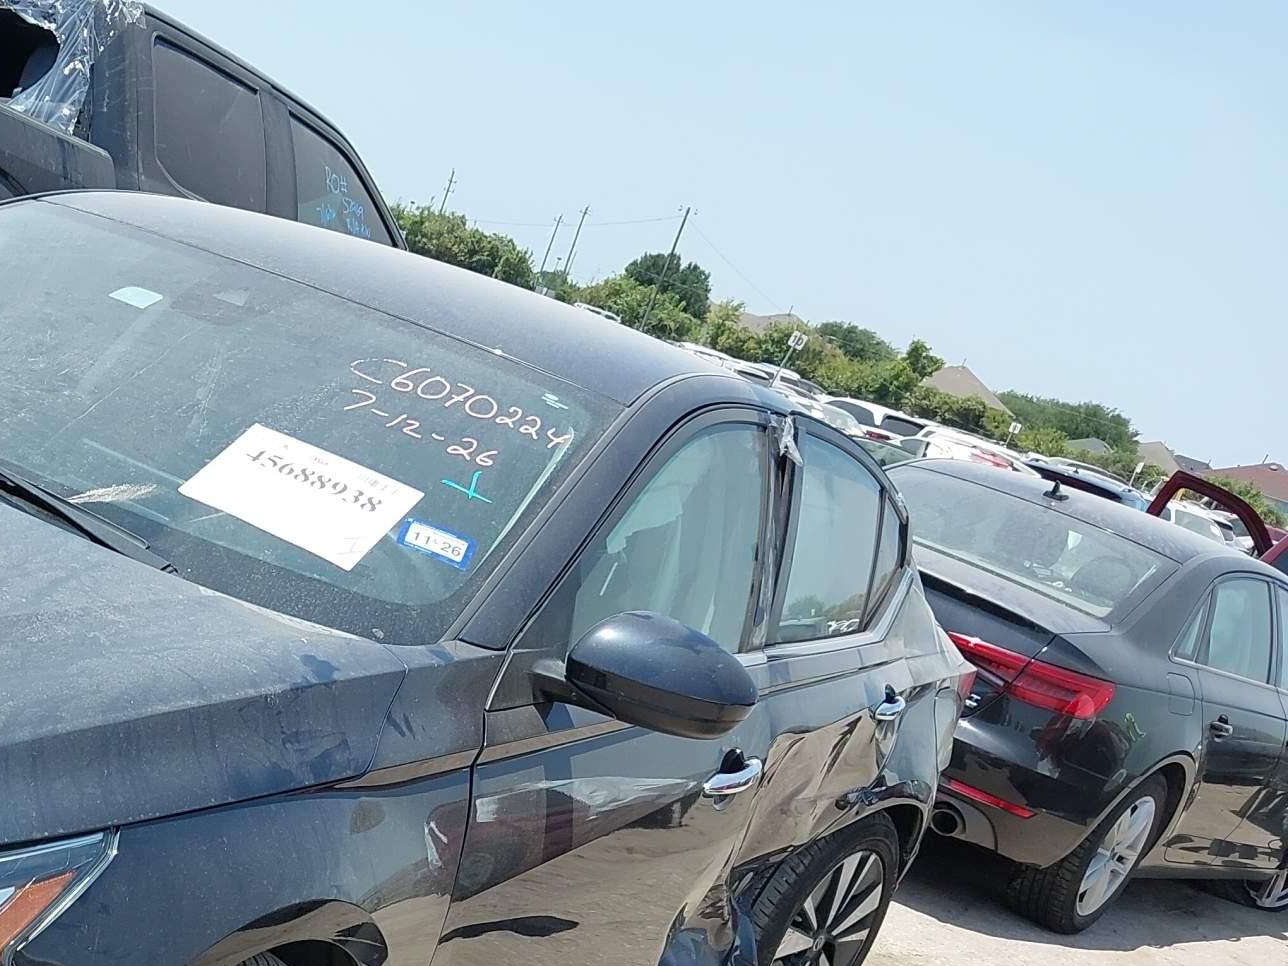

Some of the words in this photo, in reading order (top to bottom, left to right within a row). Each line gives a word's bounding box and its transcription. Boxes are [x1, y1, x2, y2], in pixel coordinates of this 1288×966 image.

[343, 389, 499, 467] 7-12-26
[350, 358, 572, 449] C6070224
[245, 449, 383, 513] 45688938
